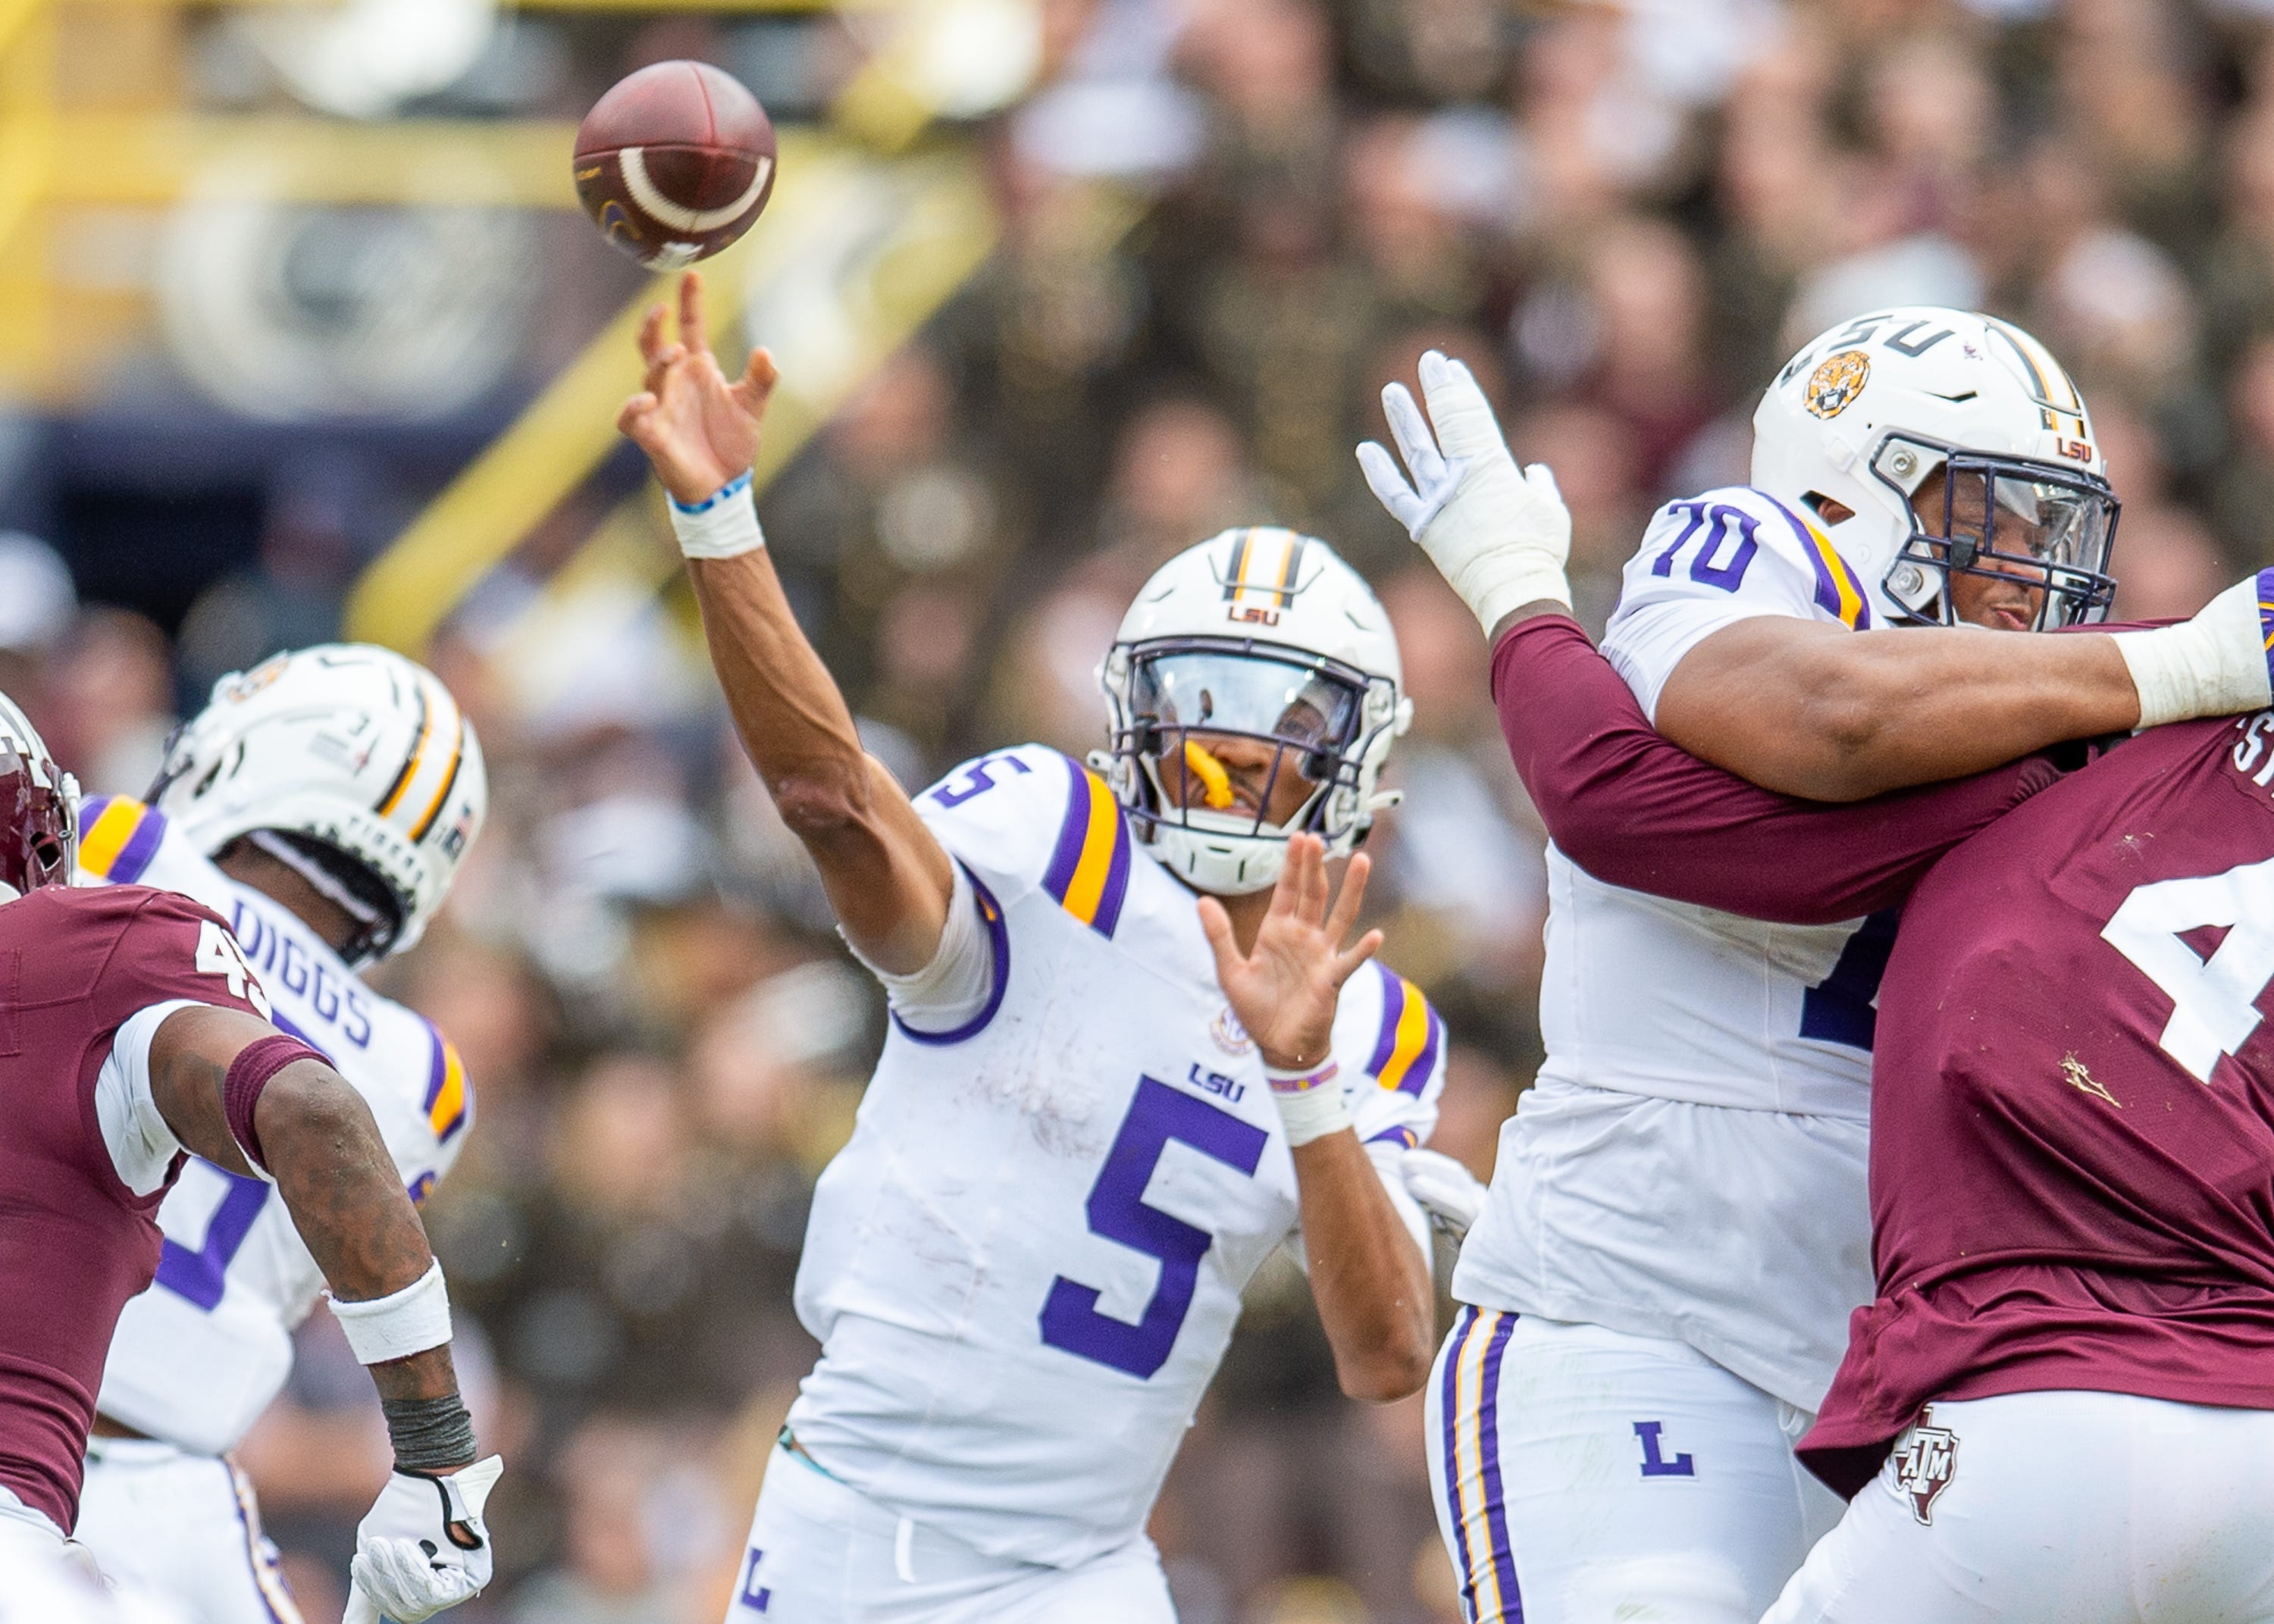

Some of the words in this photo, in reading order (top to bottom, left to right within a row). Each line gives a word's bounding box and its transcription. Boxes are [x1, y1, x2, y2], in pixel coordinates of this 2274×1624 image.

[1780, 314, 1956, 388] LSU
[2057, 437, 2091, 464] LSU
[1651, 502, 1762, 593] 70
[1228, 605, 1280, 627] LSU
[932, 756, 1032, 808] 5
[232, 900, 371, 1049] DIGGS
[1188, 1062, 1245, 1103] LSU
[1038, 1073, 1269, 1381] 5
[1632, 1420, 1695, 1477] L
[741, 1547, 772, 1613] L
